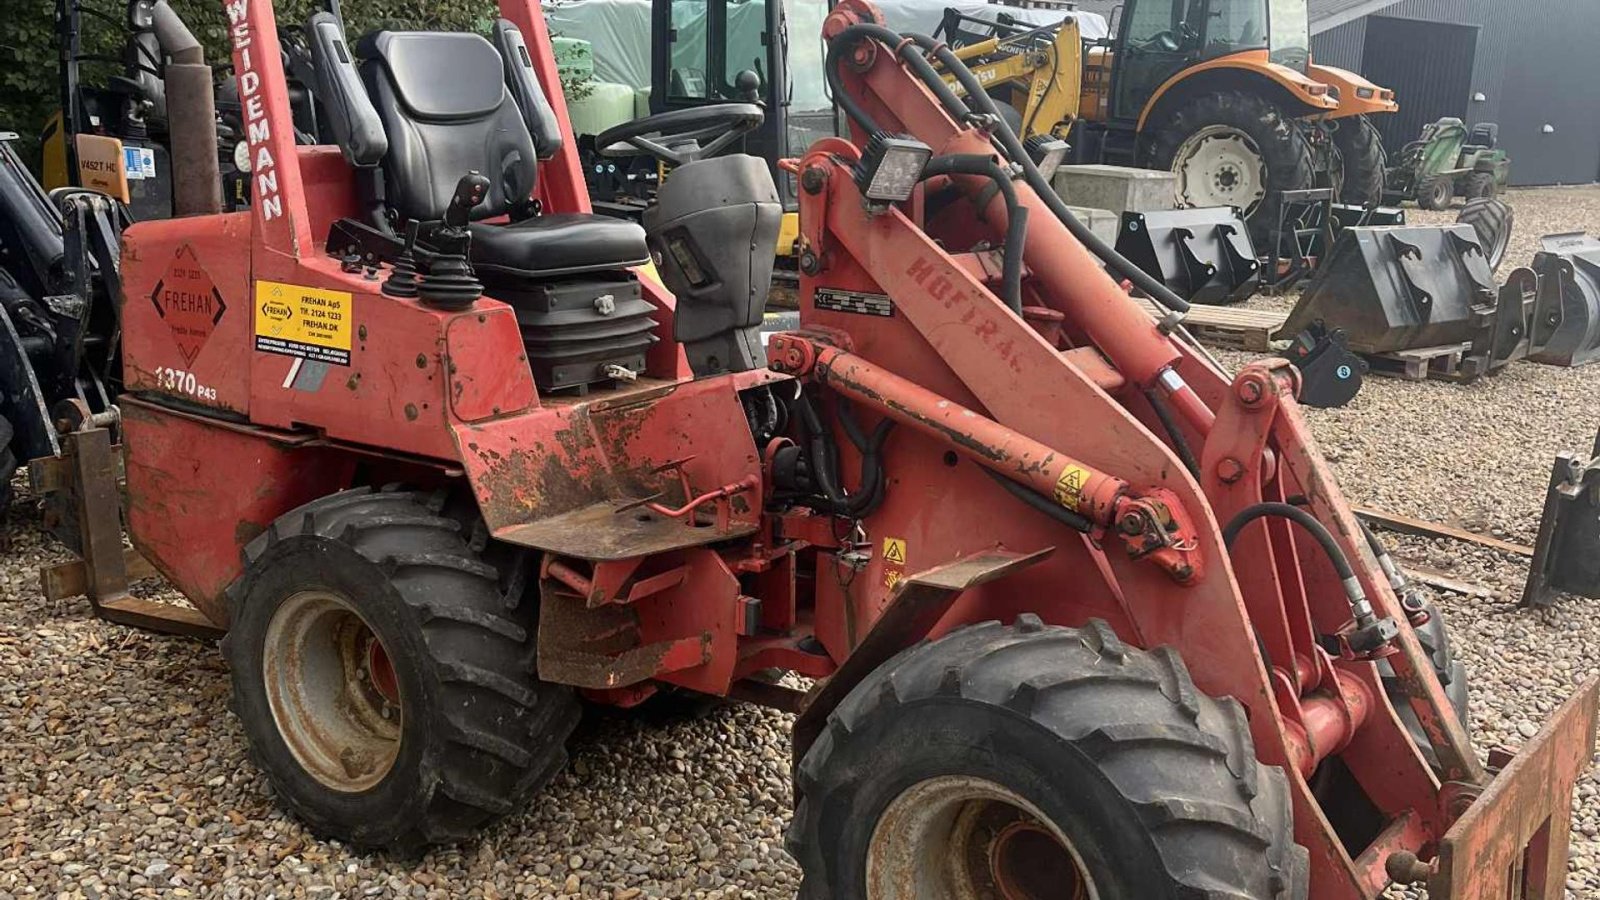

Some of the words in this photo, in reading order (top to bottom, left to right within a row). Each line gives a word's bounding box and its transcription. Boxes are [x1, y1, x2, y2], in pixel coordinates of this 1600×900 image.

[226, 0, 283, 221] WEIDEMANN
[81, 160, 103, 171] V452T
[165, 290, 212, 315] FREHAN
[301, 296, 326, 306] FREHAN
[328, 301, 341, 310] ApS
[266, 306, 288, 316] FREHAN
[311, 309, 326, 317] 2124
[328, 311, 342, 320] 1233
[303, 319, 338, 332] FREHAN.DK
[155, 366, 196, 395] 1370
[197, 385, 216, 400] P43
